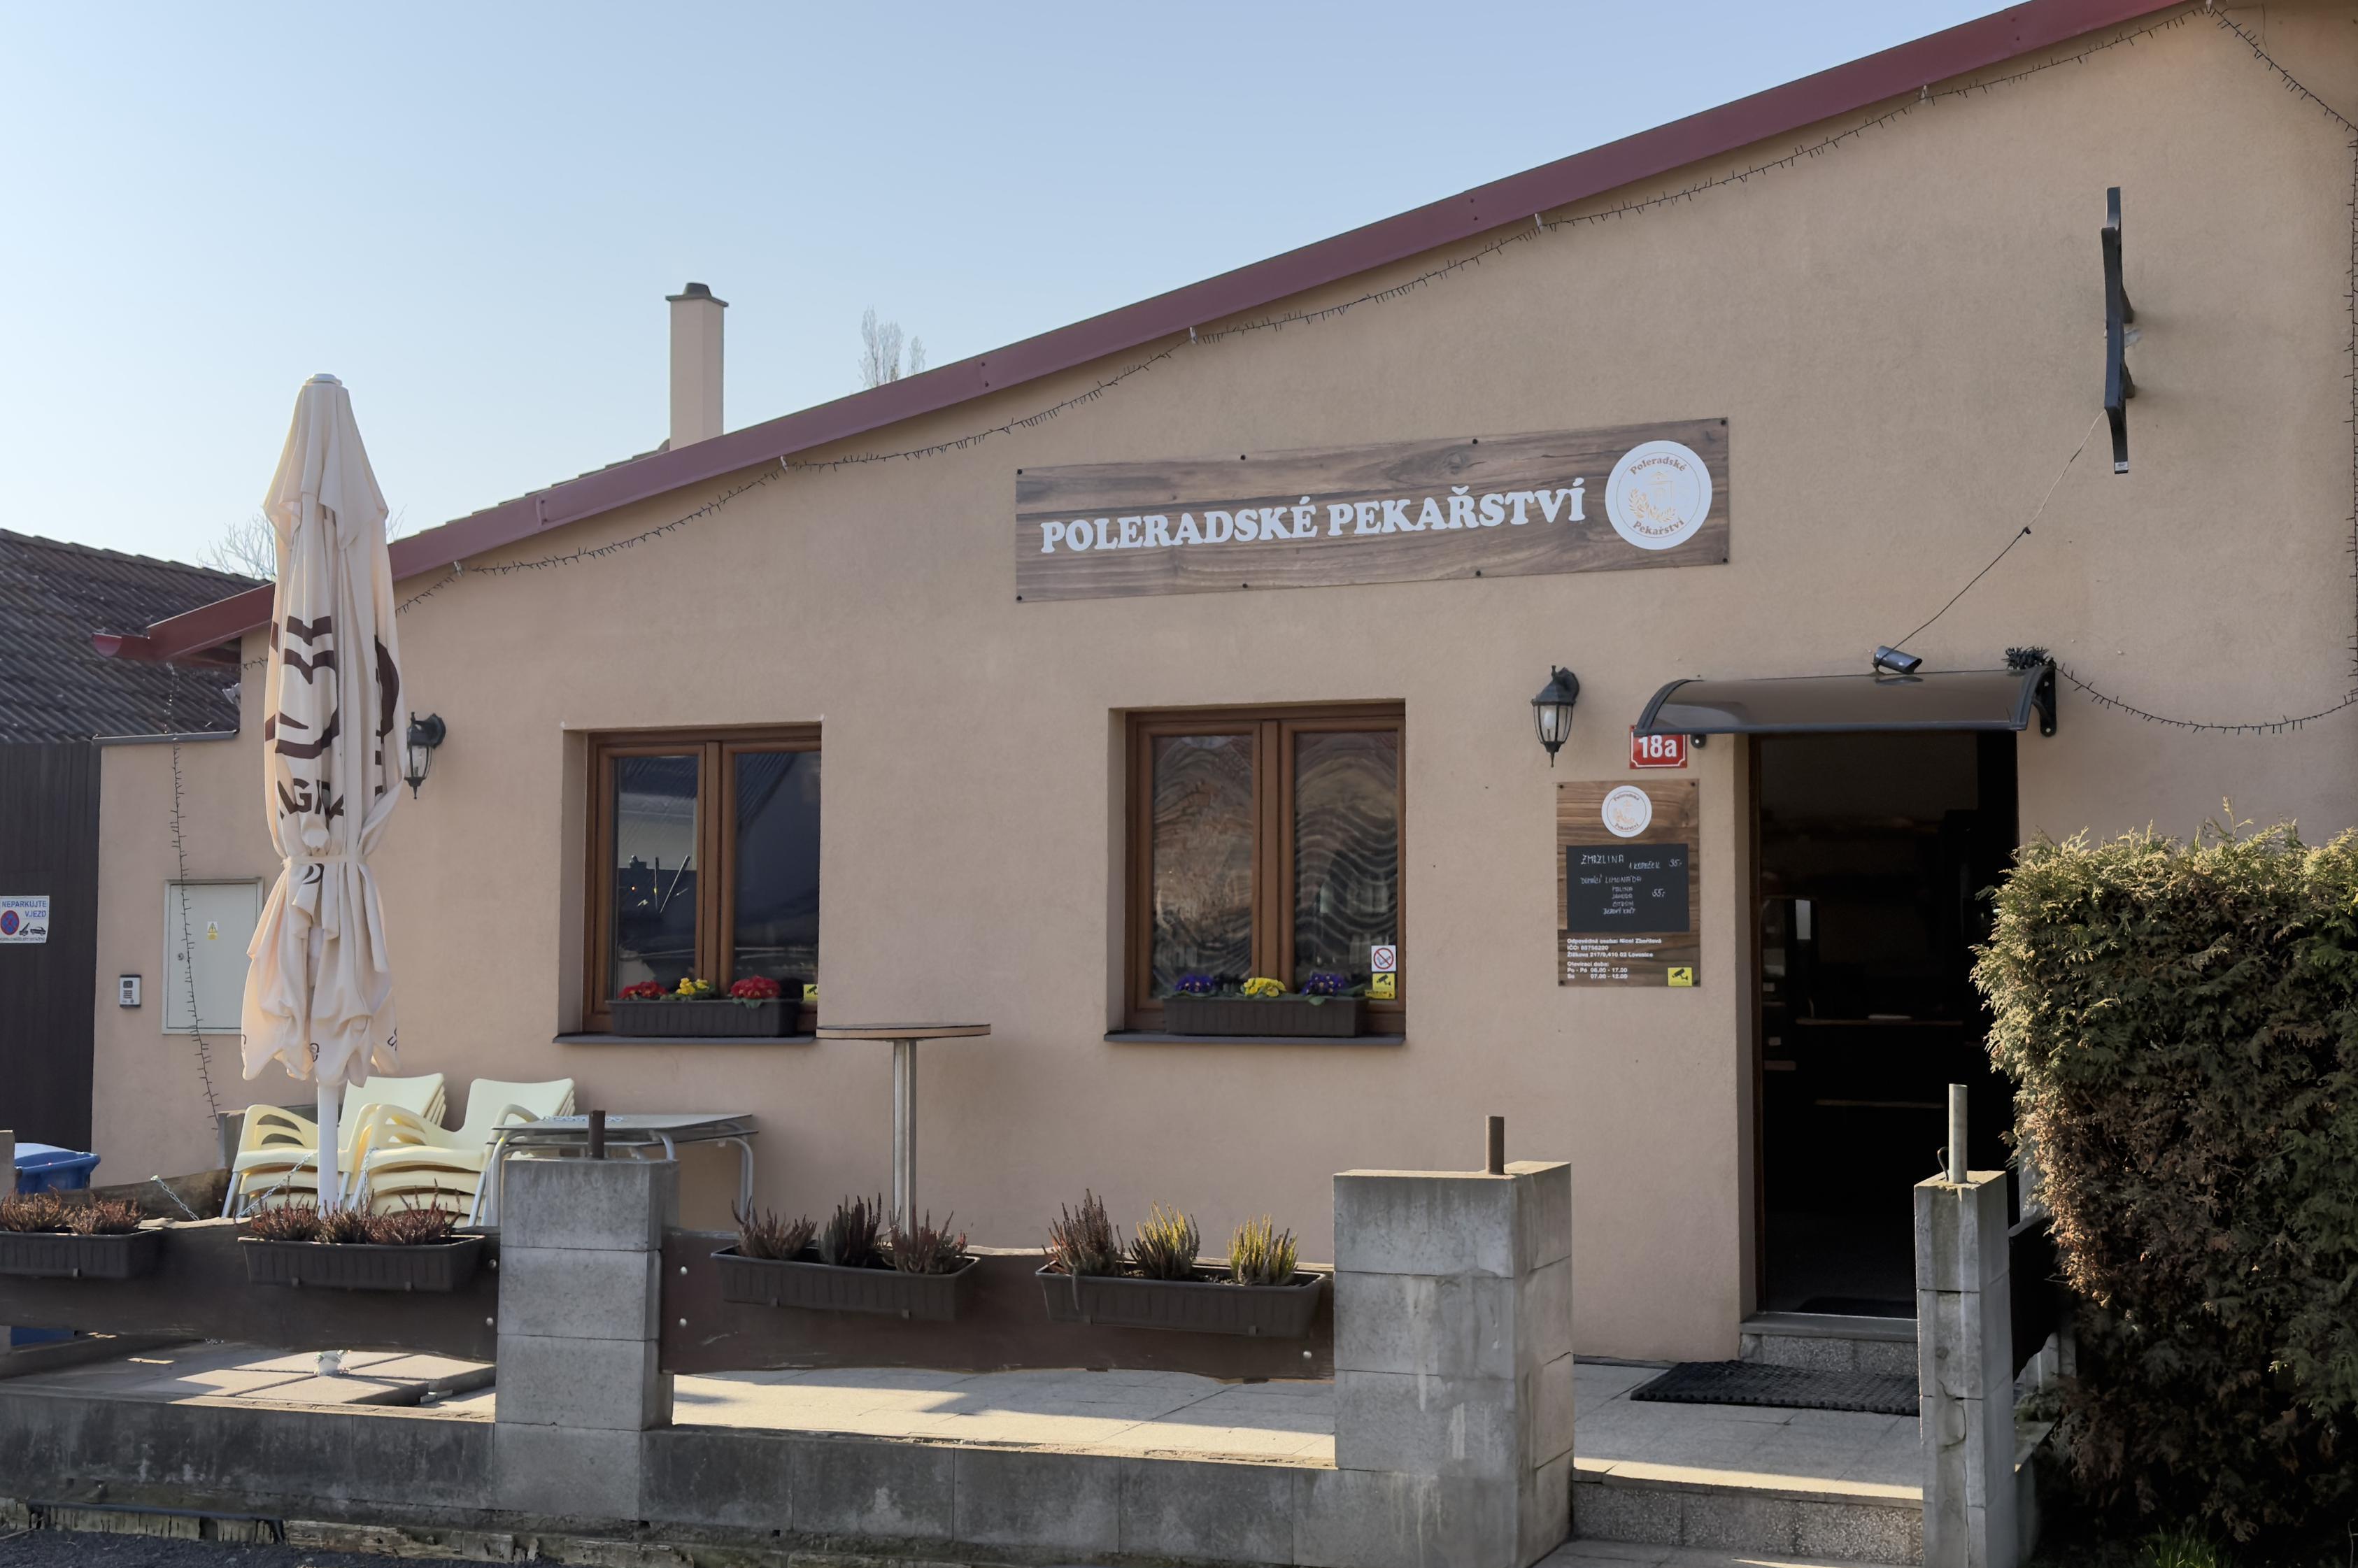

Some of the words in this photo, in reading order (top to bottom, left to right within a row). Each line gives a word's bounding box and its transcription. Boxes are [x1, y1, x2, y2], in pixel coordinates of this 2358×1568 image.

[1630, 456, 1687, 475] Poleradské
[1040, 495, 1317, 553] POLERADSKÉ
[1327, 477, 1586, 536] PEKAŘSTVÍ
[1633, 518, 1684, 535] Pekařství
[1638, 734, 1677, 758] 18a
[1581, 853, 1624, 865] ZMRZLINA
